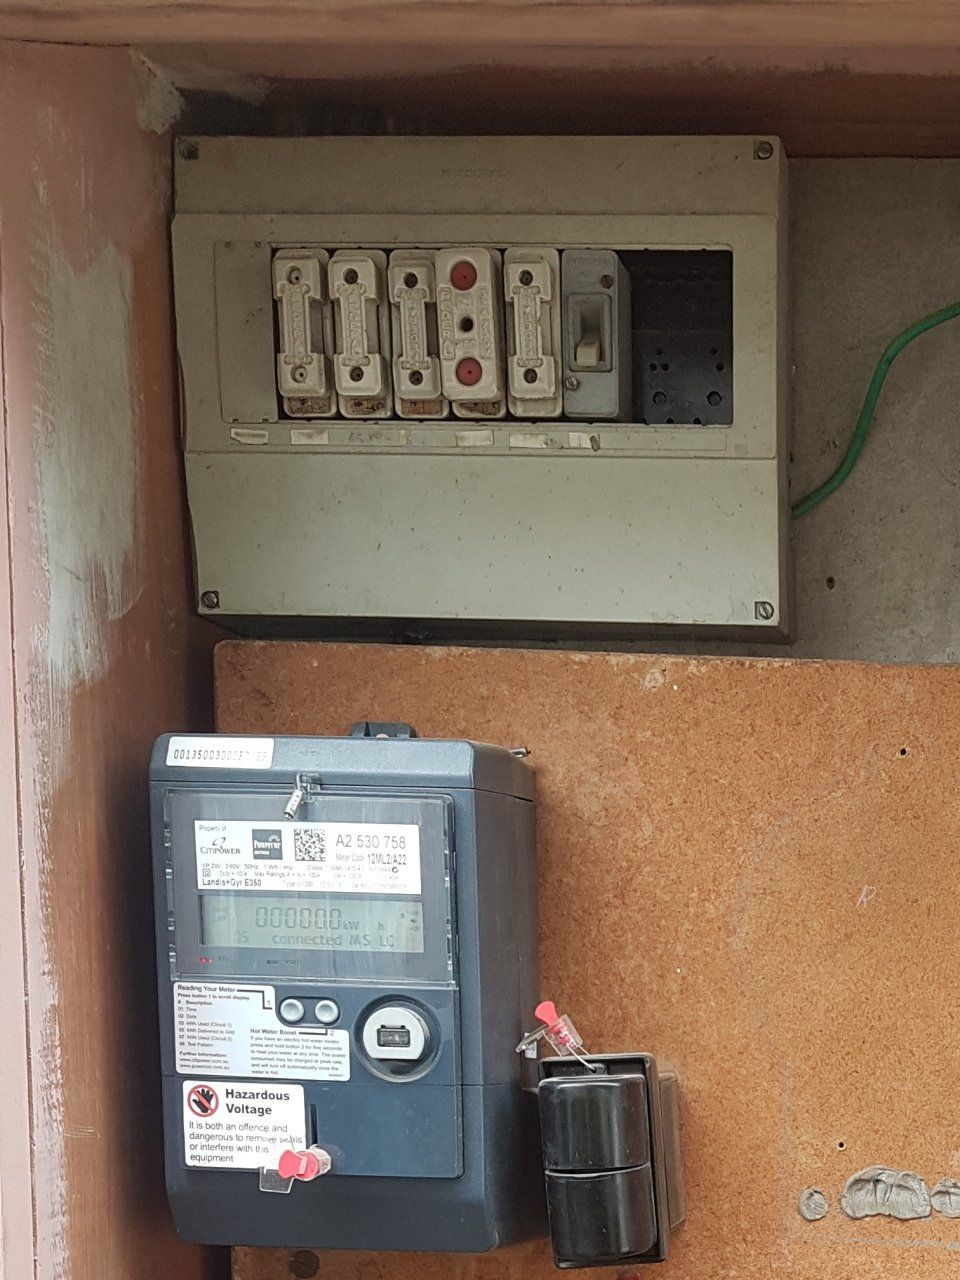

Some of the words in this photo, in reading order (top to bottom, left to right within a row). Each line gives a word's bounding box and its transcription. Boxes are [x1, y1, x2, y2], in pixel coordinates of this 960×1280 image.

[336, 834, 352, 848] A2
[357, 835, 379, 849] 530
[384, 836, 406, 849] 758
[202, 878, 243, 887] Landis+Gyr
[244, 878, 262, 886] E350
[256, 907, 341, 929] 000000
[272, 934, 342, 946] connected
[349, 935, 370, 947] MS
[379, 936, 394, 947] LC
[225, 1089, 290, 1100] Hazardous
[226, 1103, 272, 1116] Voltage
[189, 1121, 194, 1129] It
[205, 1122, 223, 1130] both
[239, 1123, 269, 1132] offence
[189, 1132, 233, 1142] dangerous
[201, 1143, 233, 1151] interfere
[190, 1154, 234, 1163] equipment
